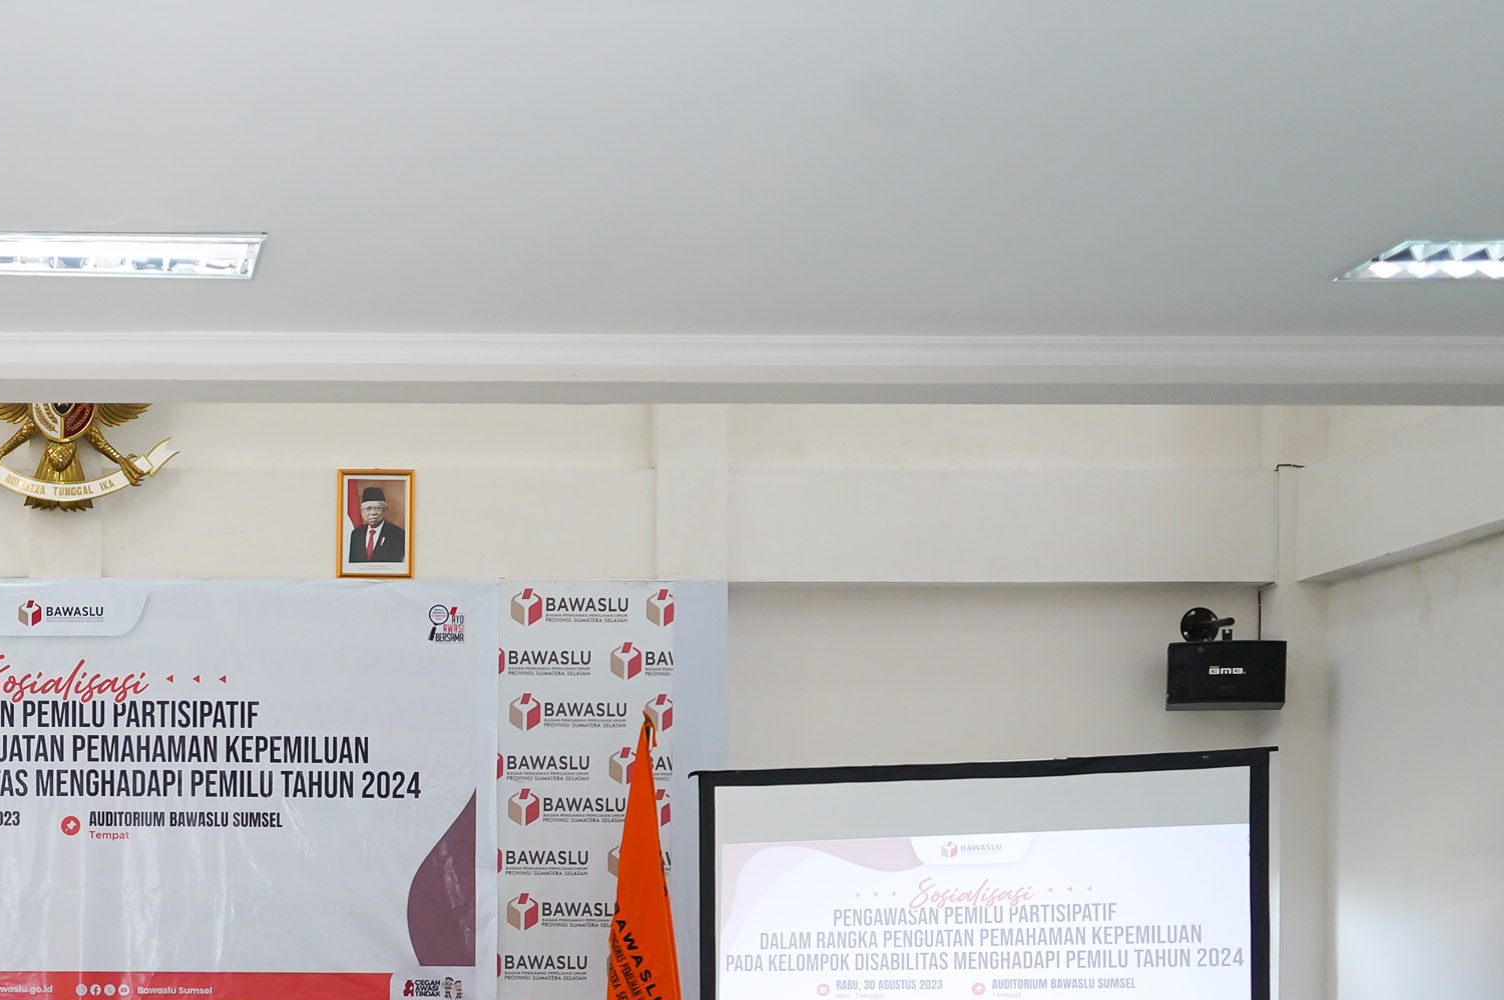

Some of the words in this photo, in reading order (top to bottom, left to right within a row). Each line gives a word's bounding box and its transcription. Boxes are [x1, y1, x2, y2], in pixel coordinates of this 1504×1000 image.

[53, 486, 94, 497] TUNGGAL
[99, 479, 116, 492] IKA
[46, 606, 103, 616] BAWASLU
[546, 597, 628, 612] BAWASLU
[508, 650, 591, 665] BAWASLU
[23, 701, 105, 728] PEMILU
[113, 701, 259, 728] PARTISIPATIF
[544, 702, 627, 717] BAWASLU
[73, 735, 217, 762] PEMAHAMAN
[226, 736, 368, 764] KEPEMILUAN
[507, 755, 590, 770] BAWASLU
[36, 769, 182, 797] MENGHADAPI
[191, 770, 273, 798] PEMILU
[280, 771, 353, 798] TAHUN
[362, 771, 421, 798] 2024
[543, 797, 626, 812] BAWASLU
[89, 811, 165, 827] AUDITORIUM
[170, 811, 228, 827] BAWASLU
[233, 812, 283, 828] SUMSEL
[89, 830, 129, 840] Tempat
[960, 843, 1002, 852] BAWASLU
[506, 850, 588, 865] BAWASLU
[908, 877, 1032, 910] Sosialisasi
[834, 907, 938, 926] PENGAWASAN
[945, 905, 1003, 925] PEMILU
[1009, 902, 1117, 923] PARTISIPATIF
[760, 931, 811, 950] DALAM
[817, 930, 878, 949] RANGKA
[883, 929, 974, 948] PENGUATAN
[980, 926, 1086, 947] PEMAHAMAN
[1092, 924, 1202, 945] KEPEMILUAN
[505, 955, 587, 970] BAWASLU
[726, 954, 763, 972] PADA
[768, 953, 850, 972] KELOMPOK
[855, 952, 948, 971] DISABILITAS
[954, 950, 1060, 970] MENGHADAPI
[1066, 949, 1128, 969] PEMILU
[1133, 948, 1191, 968] TAHUN
[1197, 947, 1244, 968] 2024
[137, 985, 176, 995] Bawaslu
[178, 985, 213, 995] Sumsel
[836, 980, 861, 991] RABU,
[864, 980, 875, 990] 30
[878, 979, 916, 990] AGUSTUS
[919, 979, 943, 990] 2023
[992, 979, 1047, 989] AUDITORIUM
[1051, 978, 1095, 989] BAWASLU
[1097, 977, 1136, 989] SUMSEL
